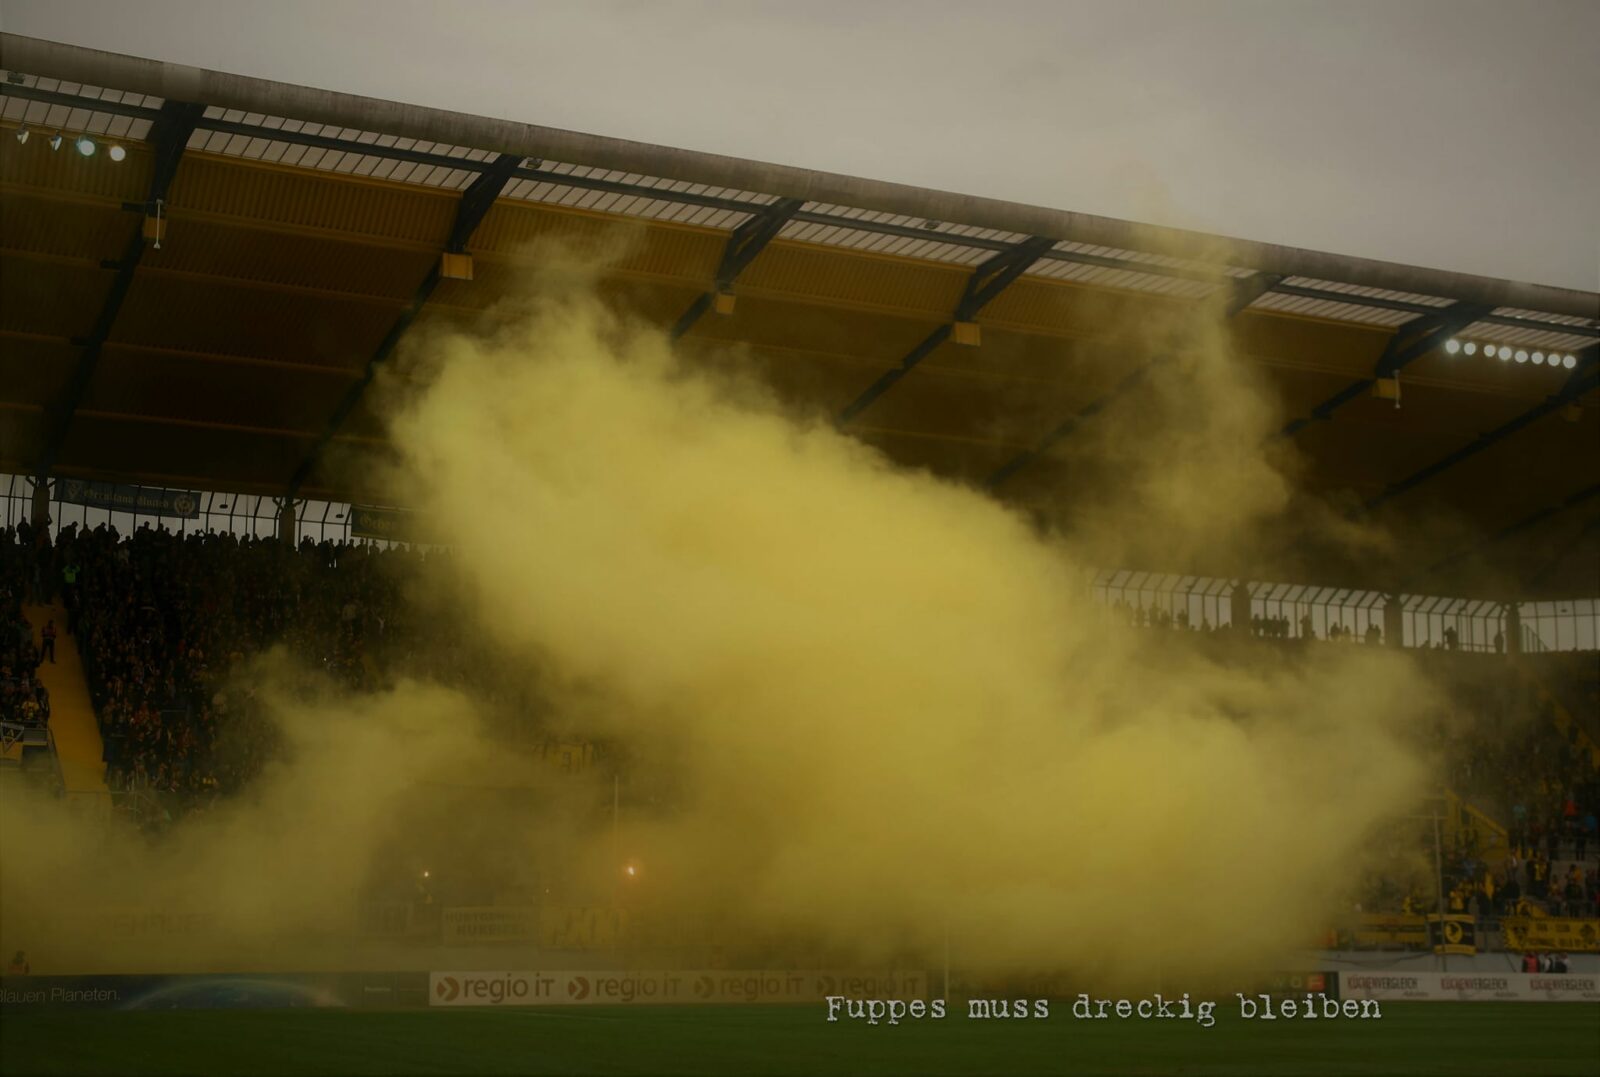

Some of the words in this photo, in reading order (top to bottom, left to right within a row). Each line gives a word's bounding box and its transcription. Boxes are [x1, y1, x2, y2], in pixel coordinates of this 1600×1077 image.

[51, 986, 121, 1003] Planeten.
[464, 972, 529, 1003] regio
[596, 972, 657, 1002] regio
[720, 972, 780, 1000] regio
[841, 972, 897, 1000] regio
